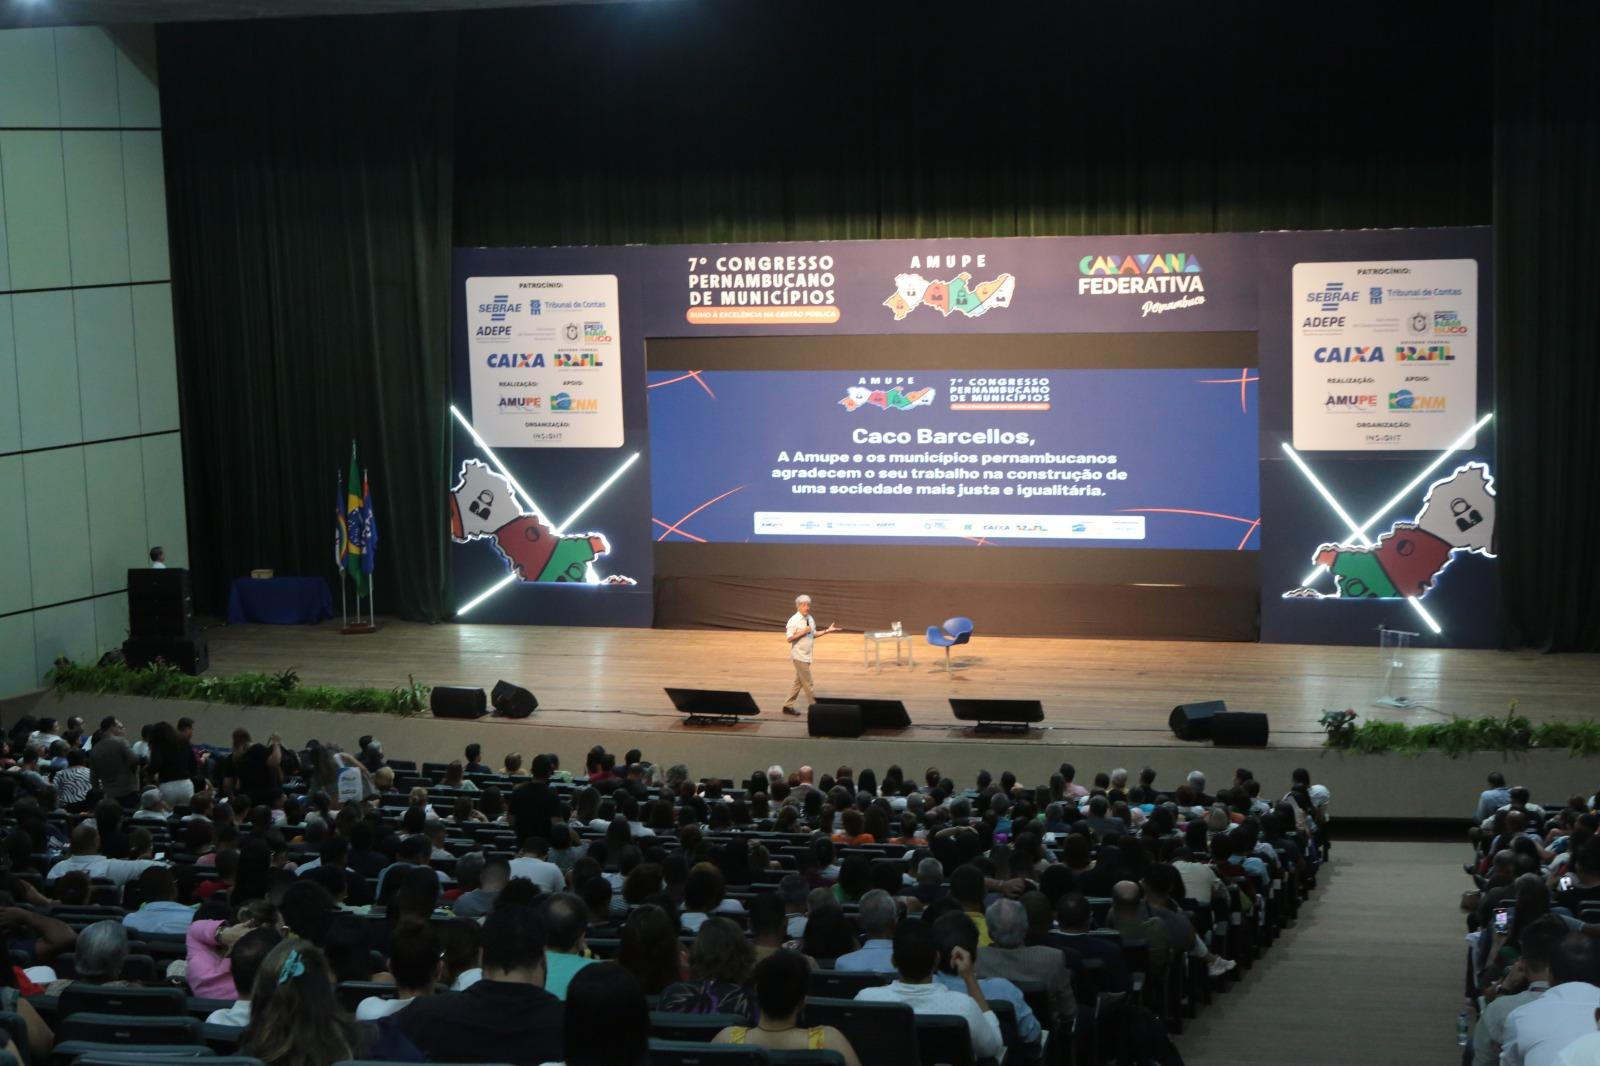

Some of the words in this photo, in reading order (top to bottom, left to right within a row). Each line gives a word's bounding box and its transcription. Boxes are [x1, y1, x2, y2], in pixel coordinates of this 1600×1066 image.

[716, 256, 834, 272] CONGRESSO
[910, 254, 986, 268] AMUPE
[688, 273, 835, 288] PERNAMBUCANO
[1078, 276, 1204, 294] FEDERATIVA
[690, 291, 712, 305] DE
[720, 288, 835, 305] MUNICÍPIOS
[1306, 292, 1360, 302] SEBRAE
[478, 303, 522, 313] SEBRAE
[1303, 316, 1346, 328] ADEPE
[476, 326, 512, 336] ADEPE
[487, 353, 545, 368] CAIXA
[1314, 347, 1384, 363] CAIXA
[950, 386, 1050, 394] PERNAMBUCANO
[972, 392, 1050, 402] MUNICÍPIOS
[498, 397, 541, 407] AMUPE
[1326, 395, 1377, 406] AMUPE
[853, 428, 911, 444] Caco
[917, 428, 1036, 446] Barcellos,
[777, 451, 790, 462] A
[793, 451, 849, 465] Amupe
[853, 454, 863, 462] e
[866, 454, 886, 463] os
[889, 452, 978, 465] municípios
[982, 452, 1117, 465] pernambucanos
[771, 467, 862, 480] agradecem
[865, 470, 875, 478] o
[878, 470, 908, 479] seu
[911, 468, 979, 479] trabalho
[983, 470, 1003, 479] na
[1007, 469, 1103, 482] construção
[1106, 469, 1128, 480] de
[792, 485, 826, 494] uma
[829, 483, 913, 494] sociedade
[916, 483, 955, 495] mais
[957, 484, 1000, 497] justa
[1003, 486, 1013, 496] e
[1017, 484, 1106, 497] igualitária.
